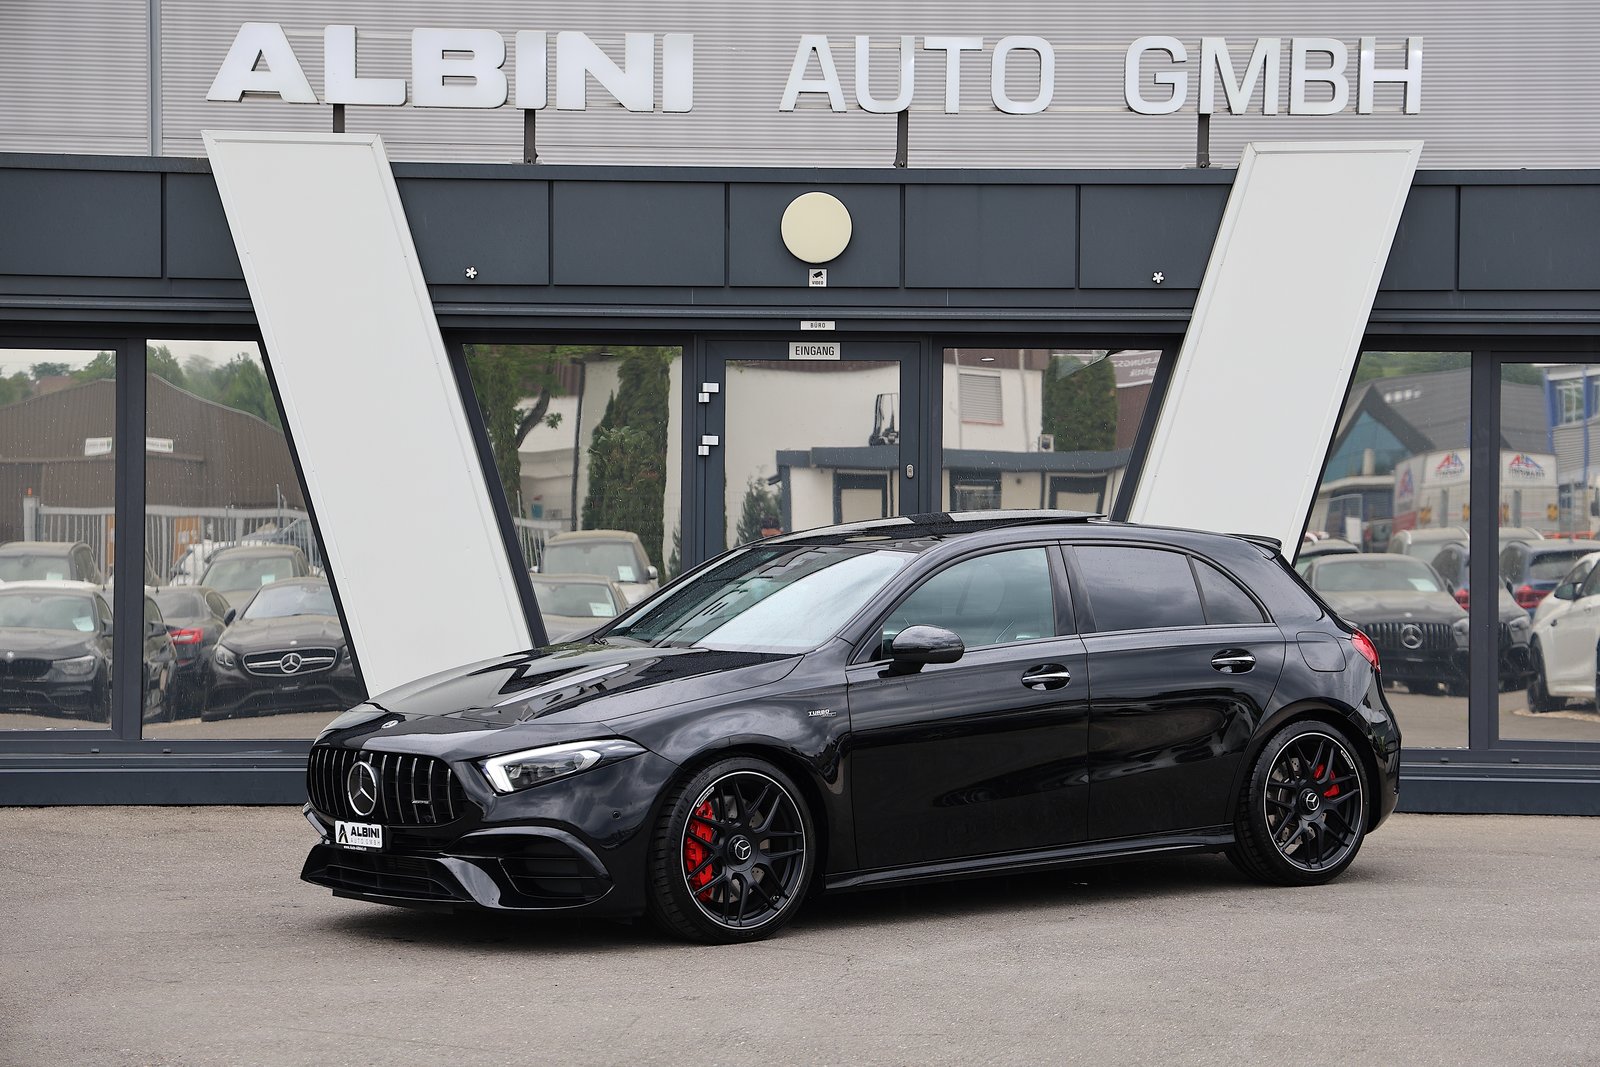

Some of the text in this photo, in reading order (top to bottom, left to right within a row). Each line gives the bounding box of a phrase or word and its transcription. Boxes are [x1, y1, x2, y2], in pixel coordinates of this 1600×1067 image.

[205, 22, 1424, 116] ALBINI AUTO GMBH
[810, 321, 826, 329] BÜRO
[795, 345, 835, 356] EINGANG
[351, 825, 380, 839] ALBINI
